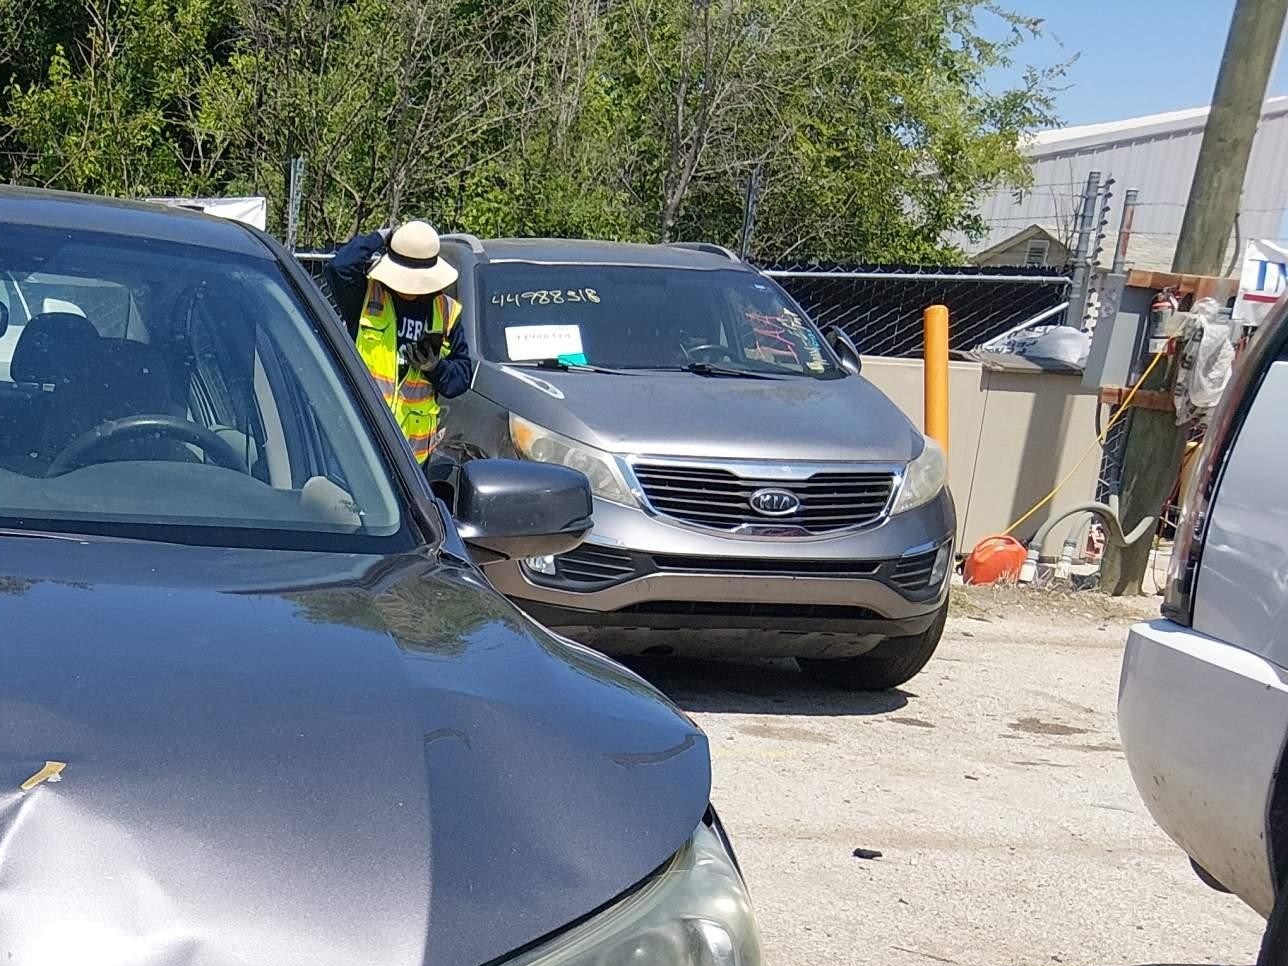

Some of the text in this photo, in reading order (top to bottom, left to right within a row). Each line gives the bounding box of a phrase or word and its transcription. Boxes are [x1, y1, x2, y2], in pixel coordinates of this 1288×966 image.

[492, 288, 601, 308] 44988318
[398, 317, 423, 341] JER
[759, 494, 790, 510] KIA
